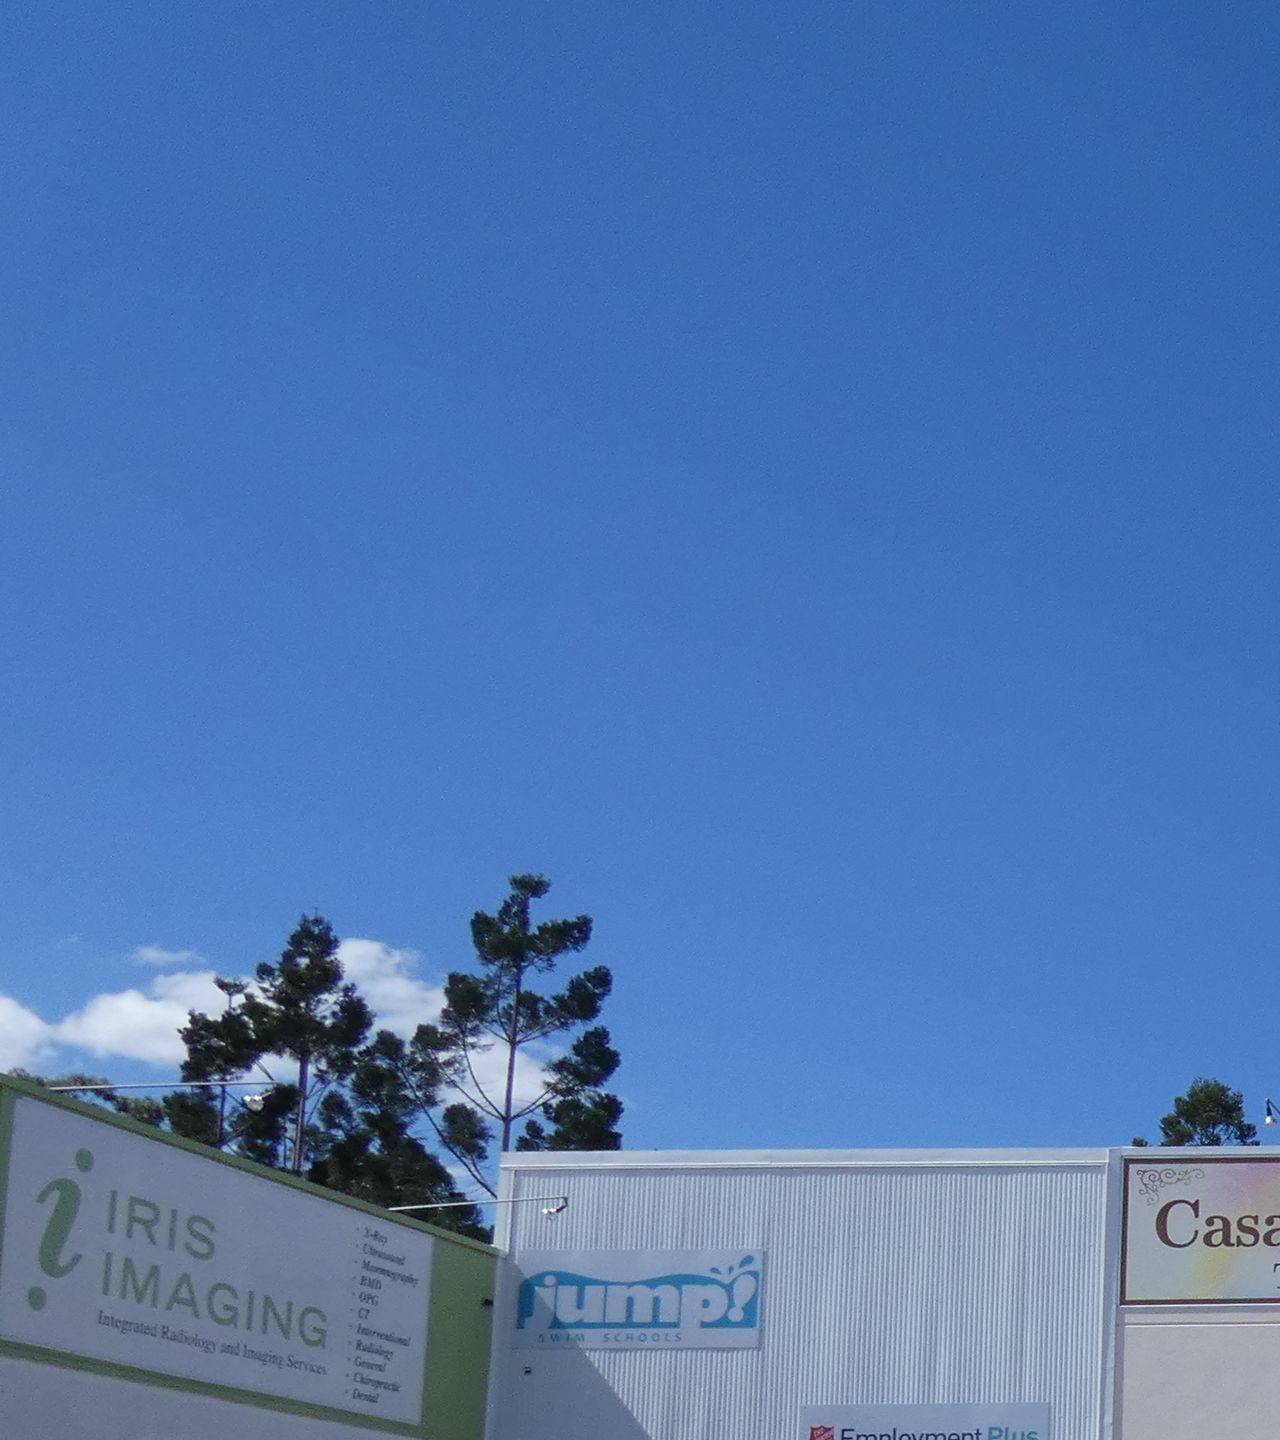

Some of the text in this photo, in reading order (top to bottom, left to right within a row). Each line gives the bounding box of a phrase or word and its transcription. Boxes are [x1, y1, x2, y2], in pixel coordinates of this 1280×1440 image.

[107, 1190, 216, 1260] IRIS
[102, 1252, 328, 1350] IMAGING
[525, 1274, 757, 1329] jump!
[538, 1333, 682, 1344] SWIM SCHOOLS
